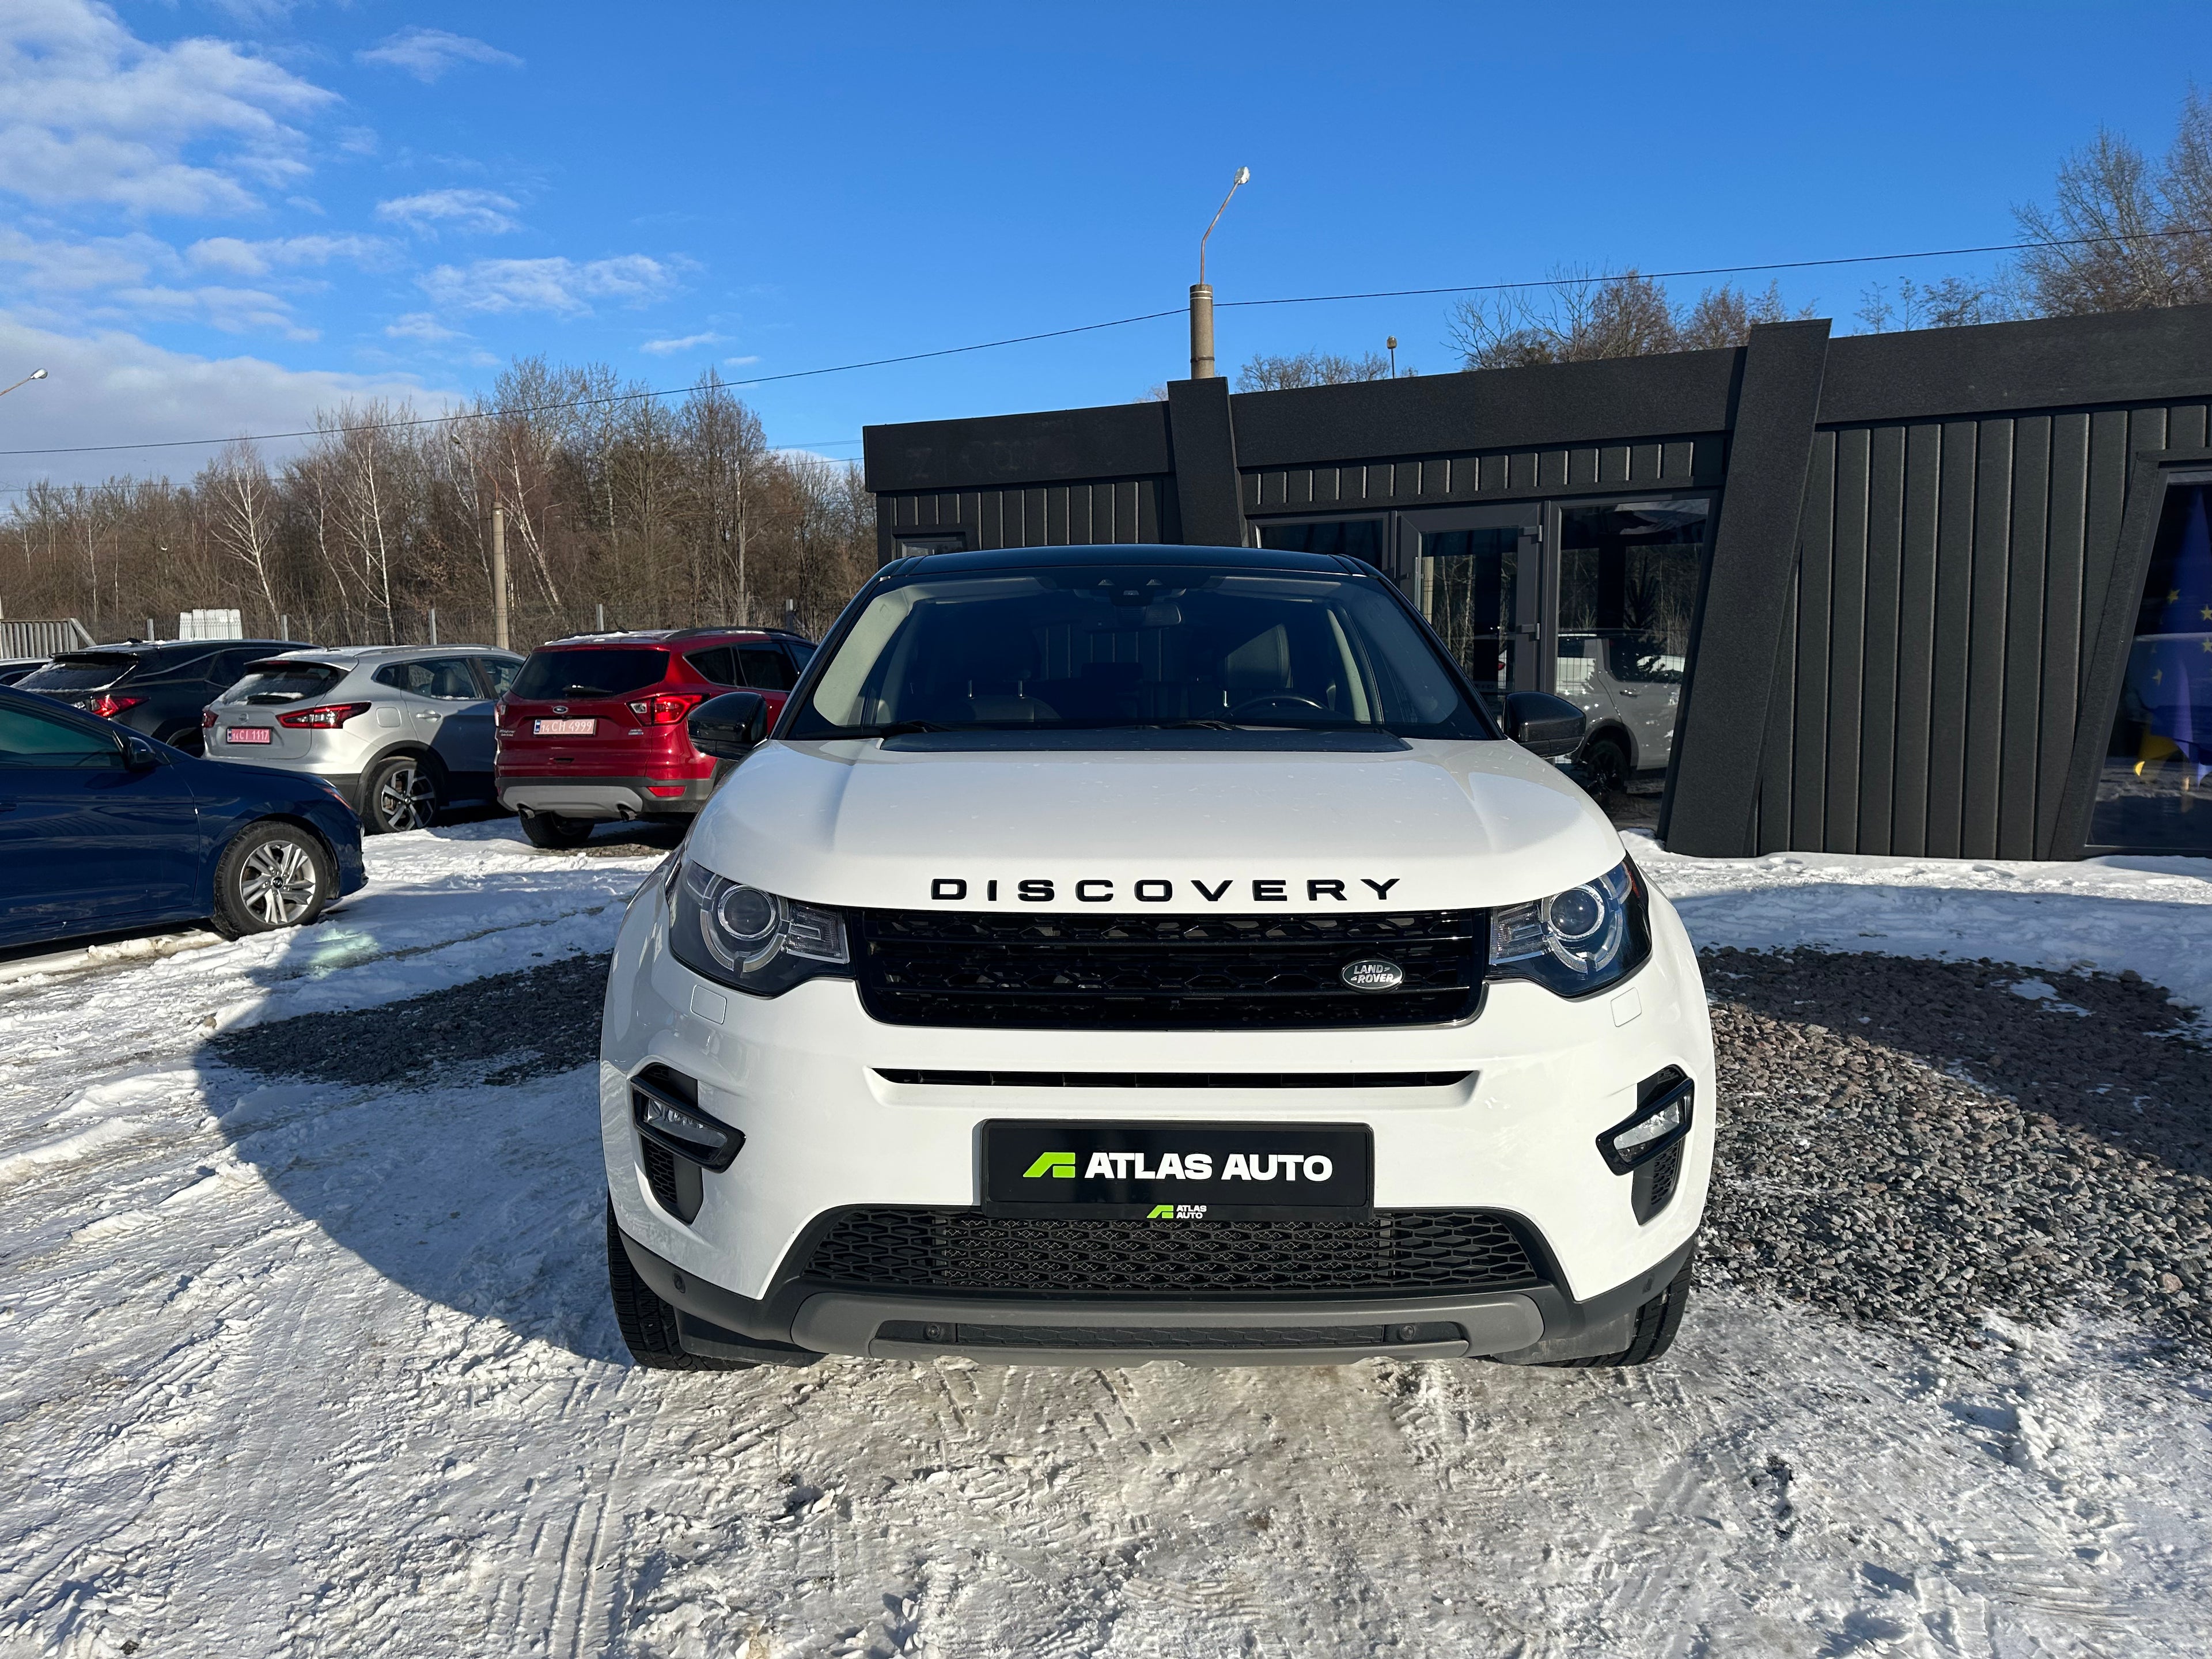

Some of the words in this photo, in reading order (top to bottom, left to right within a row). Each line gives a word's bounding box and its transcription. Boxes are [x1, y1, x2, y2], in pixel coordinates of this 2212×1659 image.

[569, 721, 592, 732] 4999
[252, 730, 268, 740] 1117
[930, 878, 1400, 902] DISCOVERY
[1354, 964, 1383, 974] LAND
[1357, 974, 1393, 983] ROVER
[1085, 1152, 1212, 1180] ATLAS
[1221, 1154, 1333, 1181] AUTO
